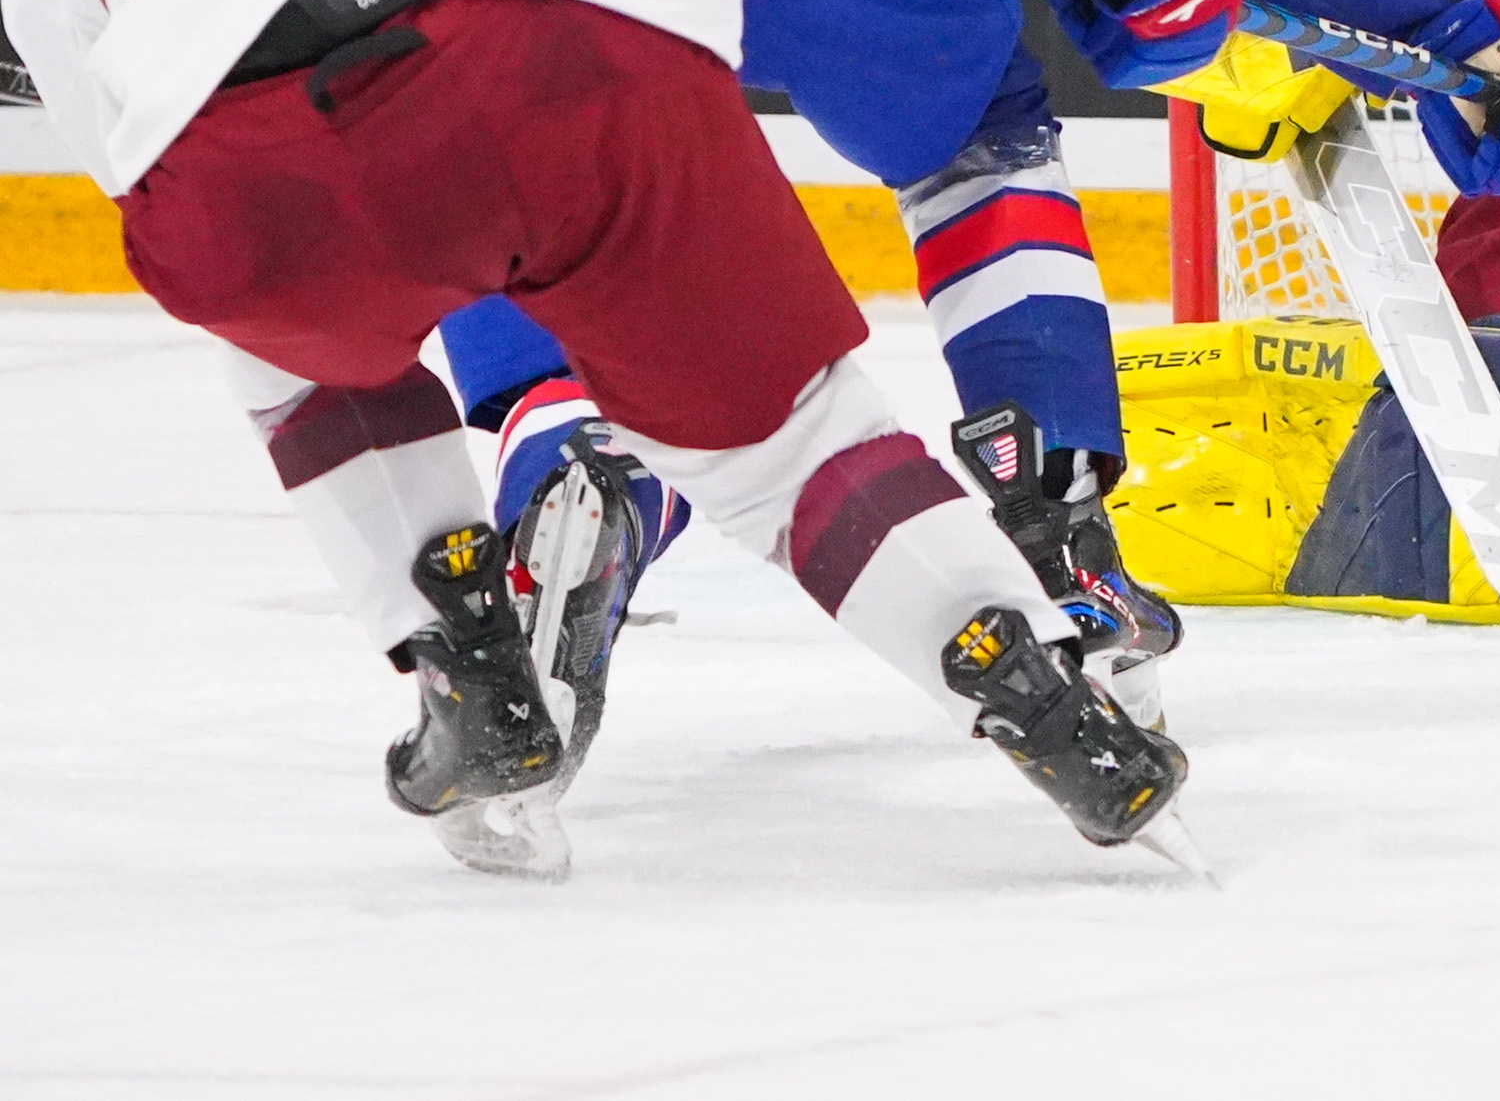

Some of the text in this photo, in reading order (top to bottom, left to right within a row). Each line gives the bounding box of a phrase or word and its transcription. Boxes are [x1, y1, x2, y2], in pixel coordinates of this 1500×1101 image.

[1318, 17, 1431, 64] CCM
[1253, 334, 1346, 382] CCM
[964, 414, 1010, 439] CCM
